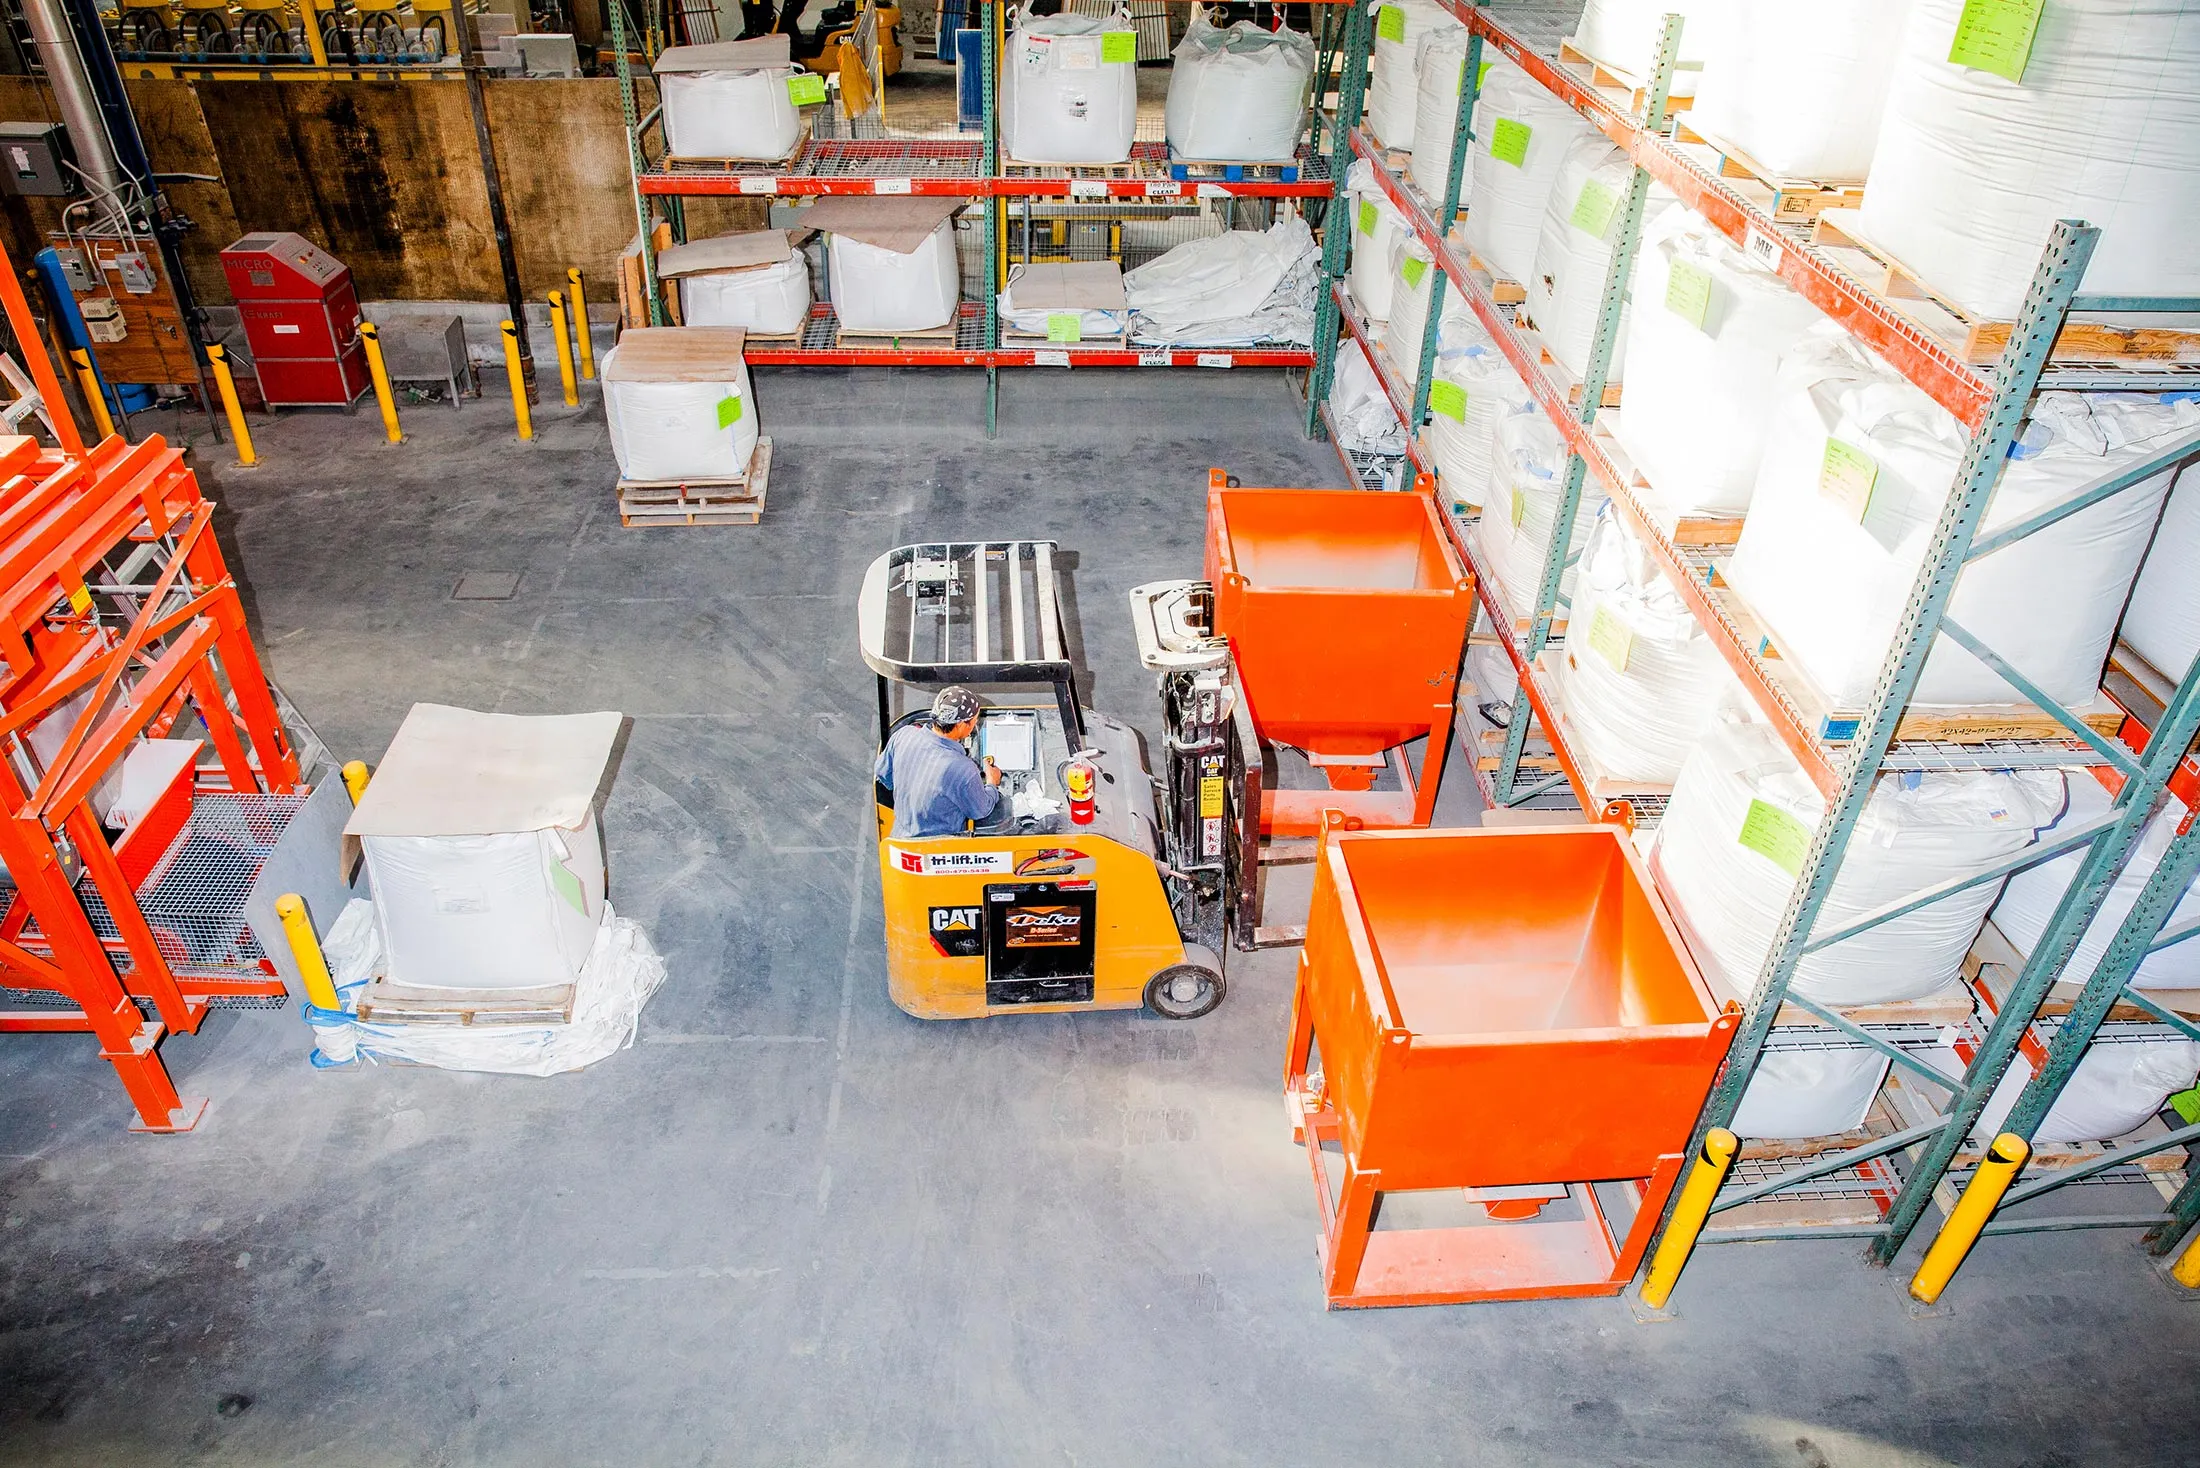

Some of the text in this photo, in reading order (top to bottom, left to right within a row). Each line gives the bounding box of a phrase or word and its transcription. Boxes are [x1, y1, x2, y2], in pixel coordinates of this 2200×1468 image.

[1753, 235, 1773, 260] MK
[226, 259, 274, 270] MICRO
[1201, 755, 1225, 768] CAT
[933, 908, 980, 931] CAT
[1006, 913, 1081, 927] Deka
